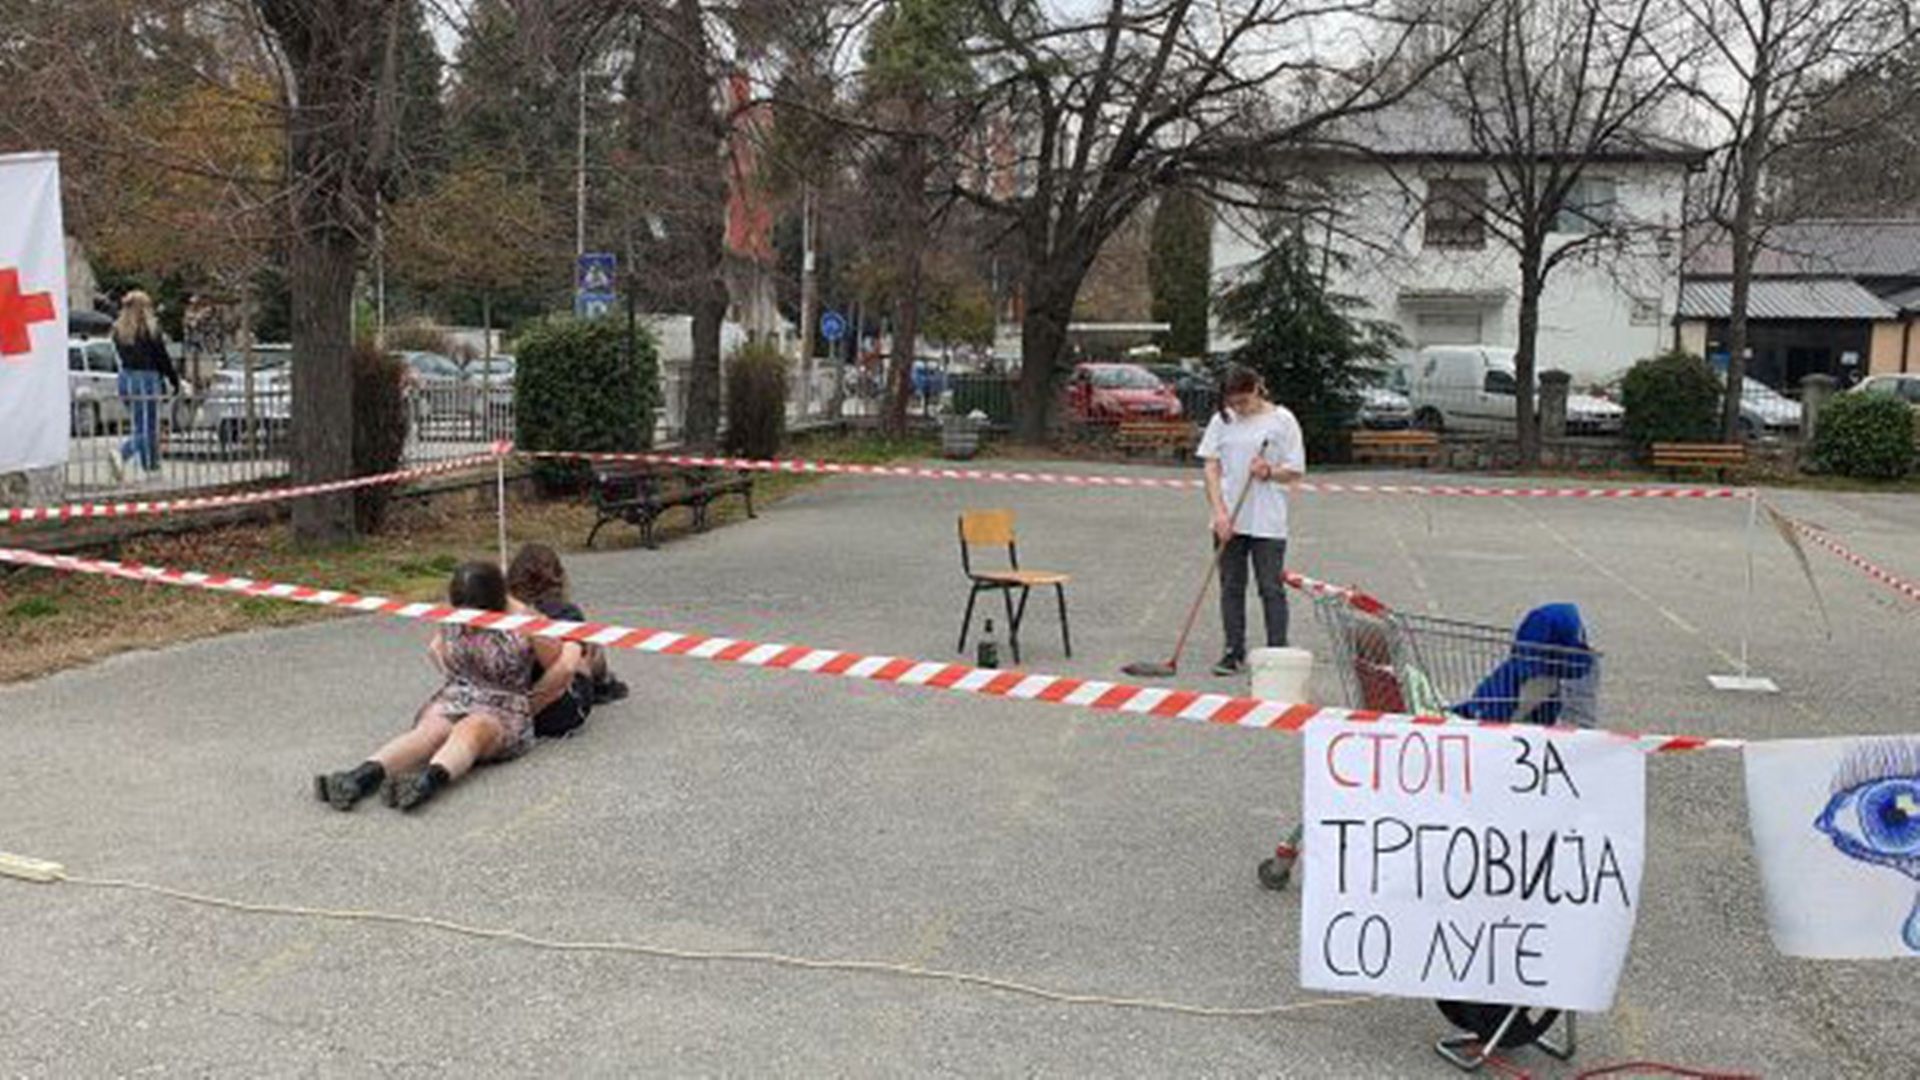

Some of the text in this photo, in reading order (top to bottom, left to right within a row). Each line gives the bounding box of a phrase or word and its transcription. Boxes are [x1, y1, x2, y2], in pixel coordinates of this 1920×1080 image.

[1327, 731, 1580, 798] СТОП ЗА
[1320, 817, 1631, 907] ТРГОВИЈА
[1324, 911, 1392, 979] СО
